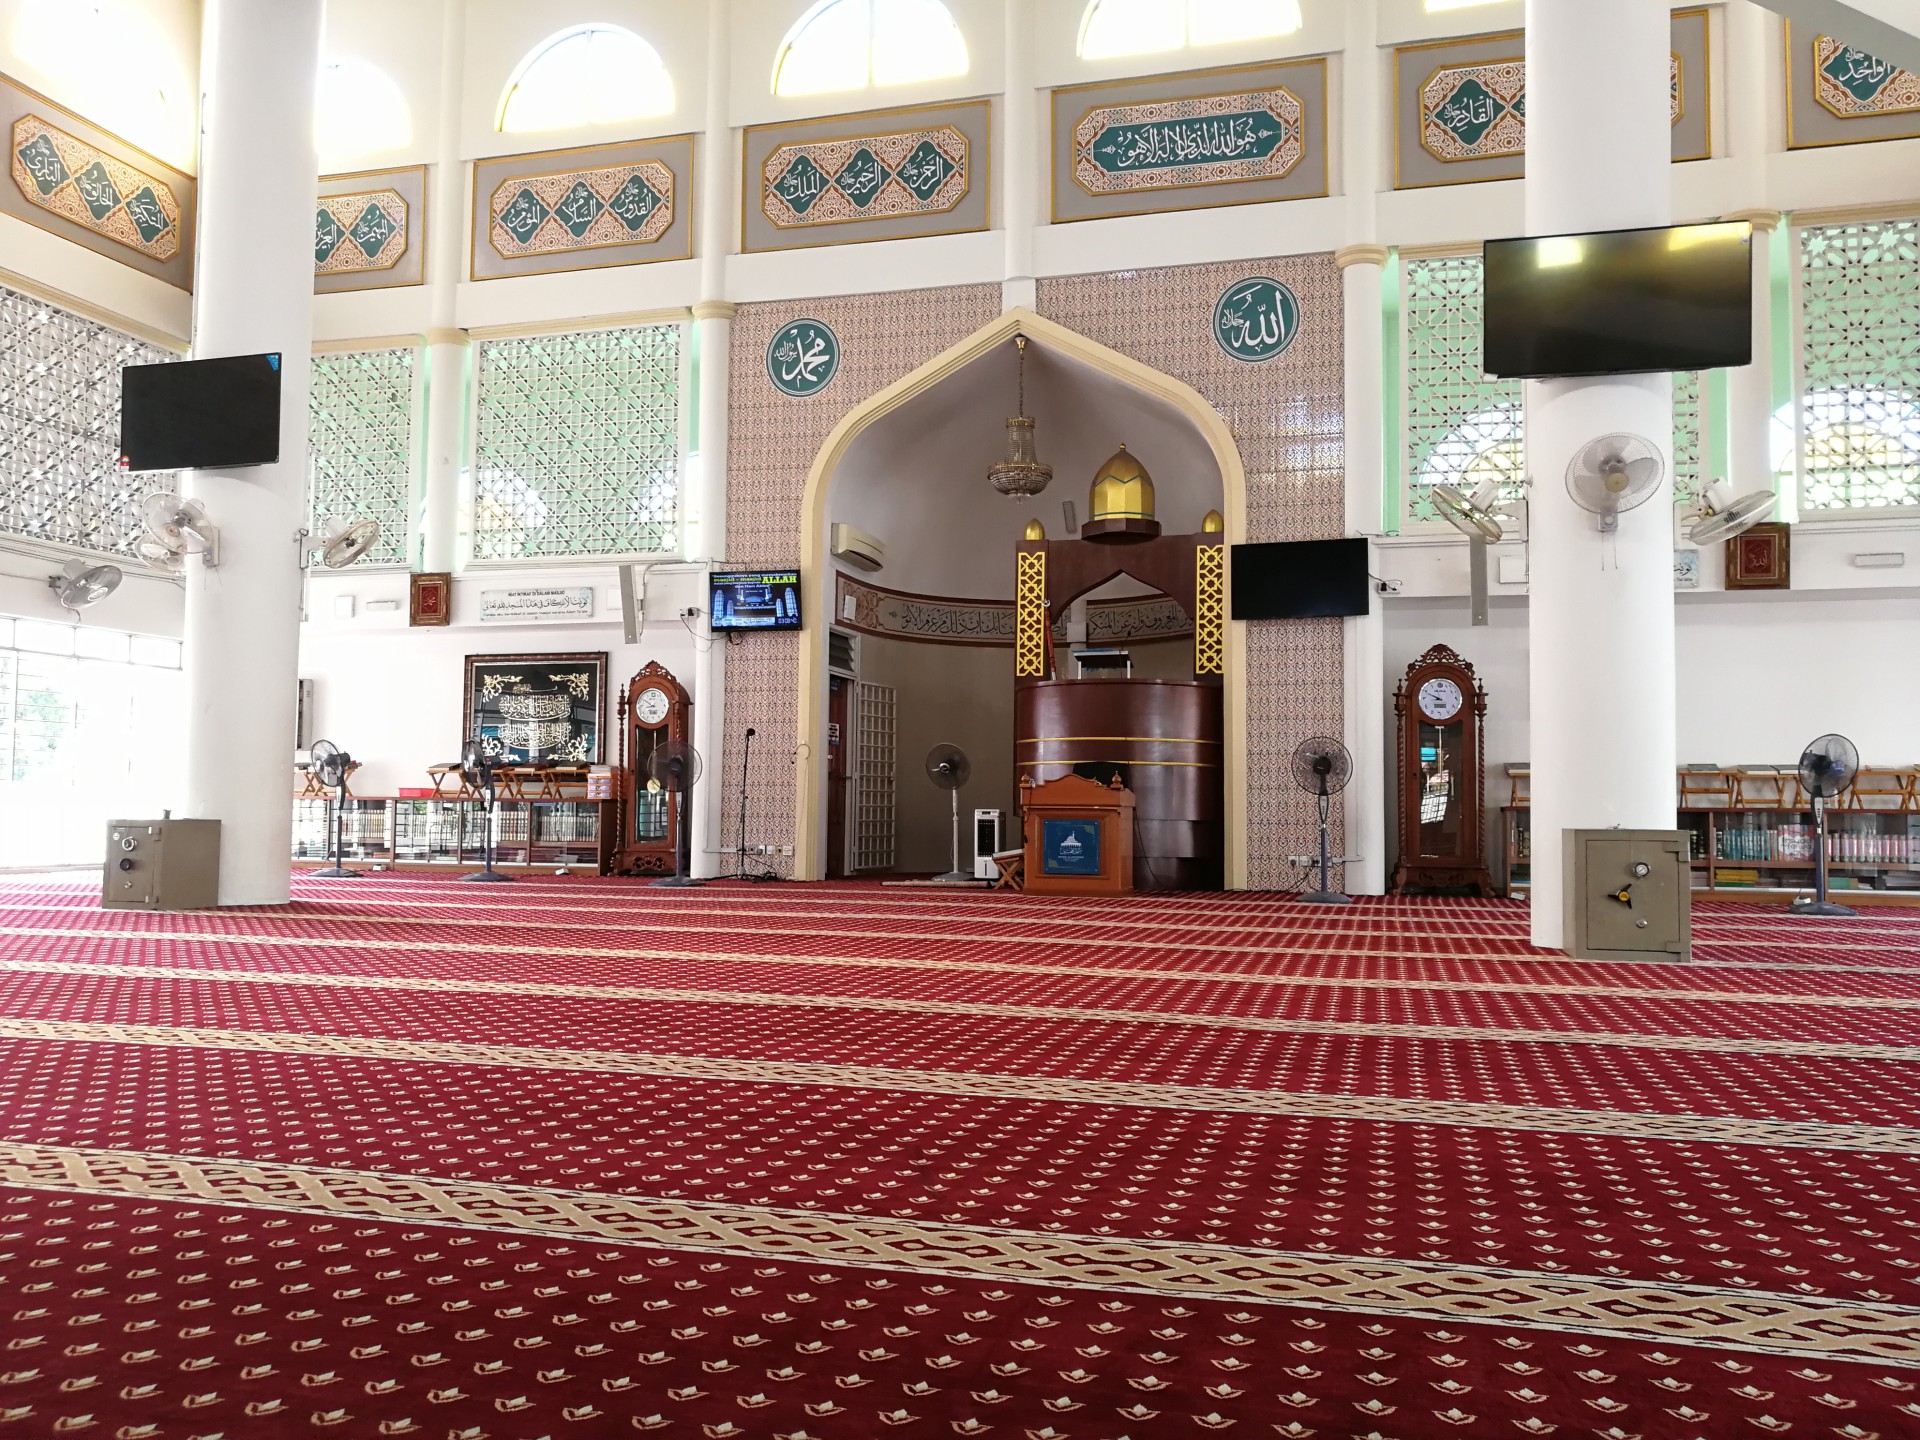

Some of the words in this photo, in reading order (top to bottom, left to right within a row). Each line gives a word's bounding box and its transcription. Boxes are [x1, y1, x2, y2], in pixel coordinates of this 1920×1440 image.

[1232, 284, 1285, 351] الله
[782, 329, 830, 388] محمد
[762, 576, 797, 584] ALLAH
